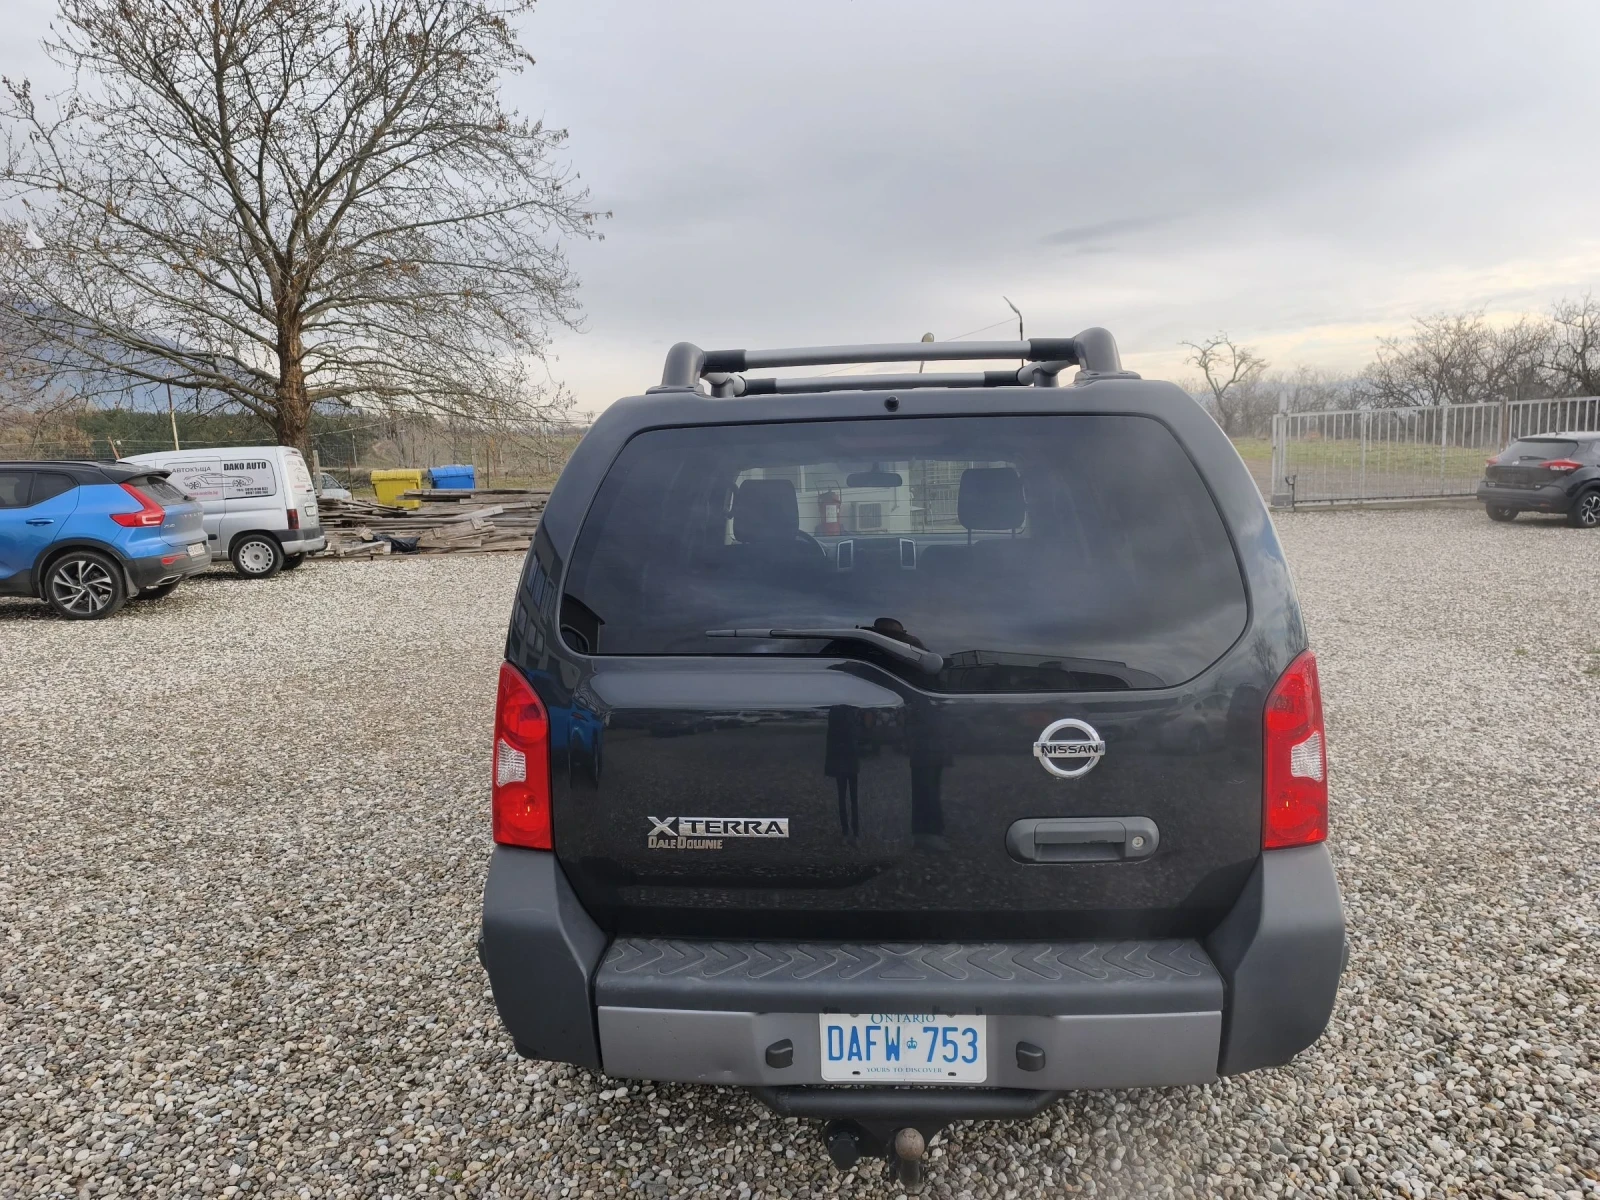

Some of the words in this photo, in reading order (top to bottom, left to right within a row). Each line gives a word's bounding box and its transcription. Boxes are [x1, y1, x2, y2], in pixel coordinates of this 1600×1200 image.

[223, 463, 245, 471] DAKO
[246, 462, 267, 470] AUTO
[1041, 744, 1099, 754] NISSAN
[871, 1013, 936, 1024] ONTARIO
[827, 1025, 901, 1062] DAFW
[922, 1026, 979, 1064] 753
